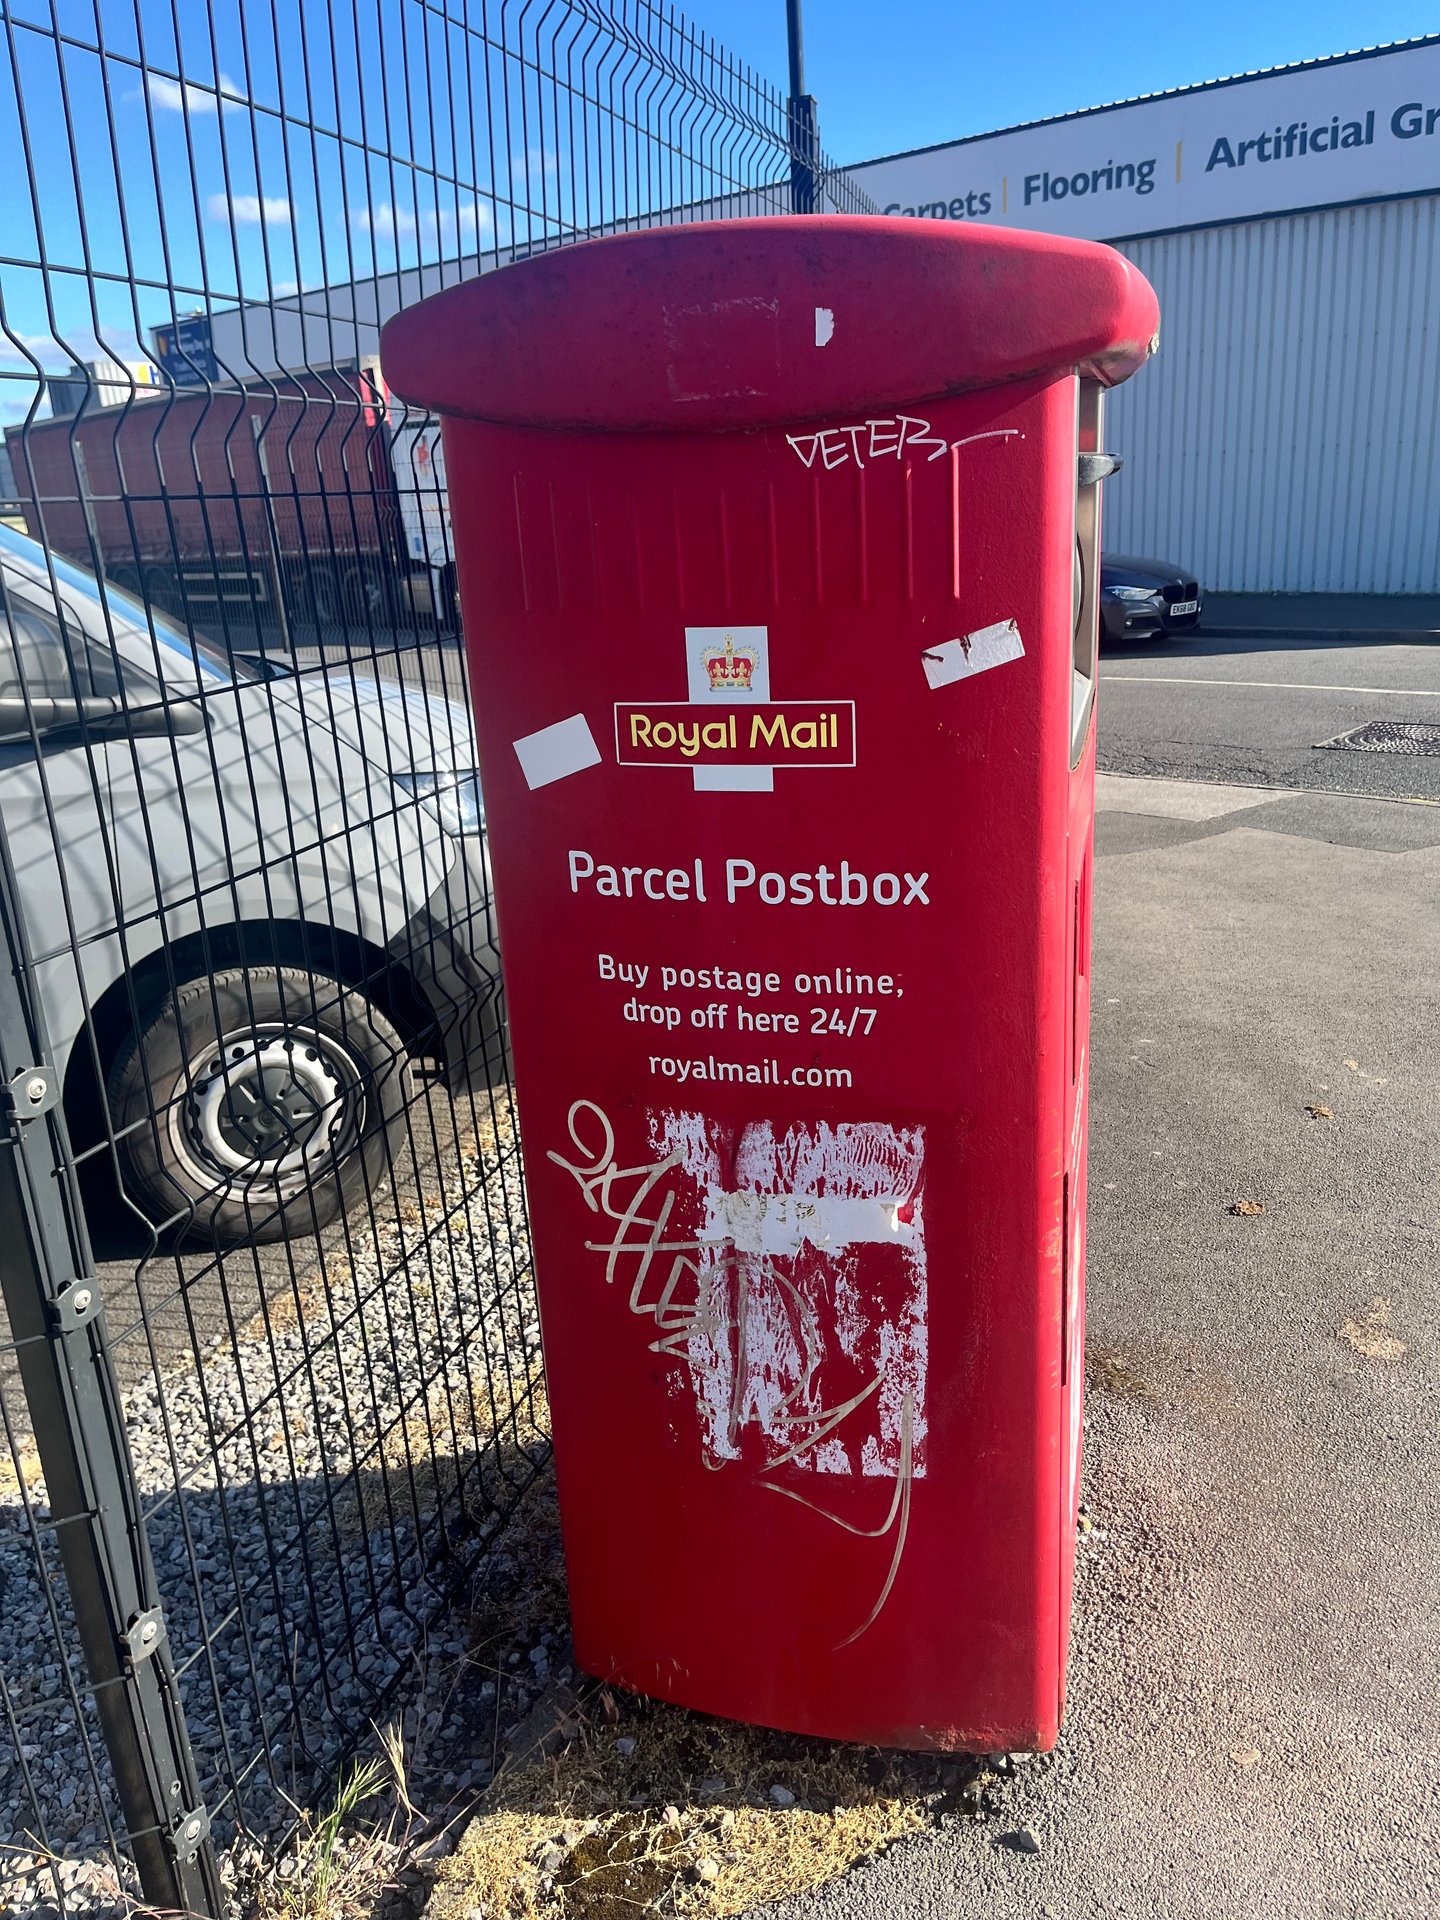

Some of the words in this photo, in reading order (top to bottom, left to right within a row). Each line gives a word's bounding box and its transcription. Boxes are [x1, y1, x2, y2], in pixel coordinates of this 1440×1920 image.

[1023, 158, 1156, 206] Flooring
[1205, 110, 1375, 172] Artificial
[1390, 102, 1440, 139] Gr
[630, 714, 736, 757] Royal
[749, 713, 838, 748] Mail
[568, 850, 706, 902] Parcel
[726, 859, 930, 906] Postbox
[598, 954, 649, 987] Buy
[661, 965, 780, 997] postage
[795, 967, 904, 998] online,
[623, 997, 681, 1030] drop
[690, 1003, 728, 1029] off
[737, 1006, 799, 1033] here
[810, 1006, 878, 1037] 24/7
[648, 1056, 852, 1087] royalmail.com
